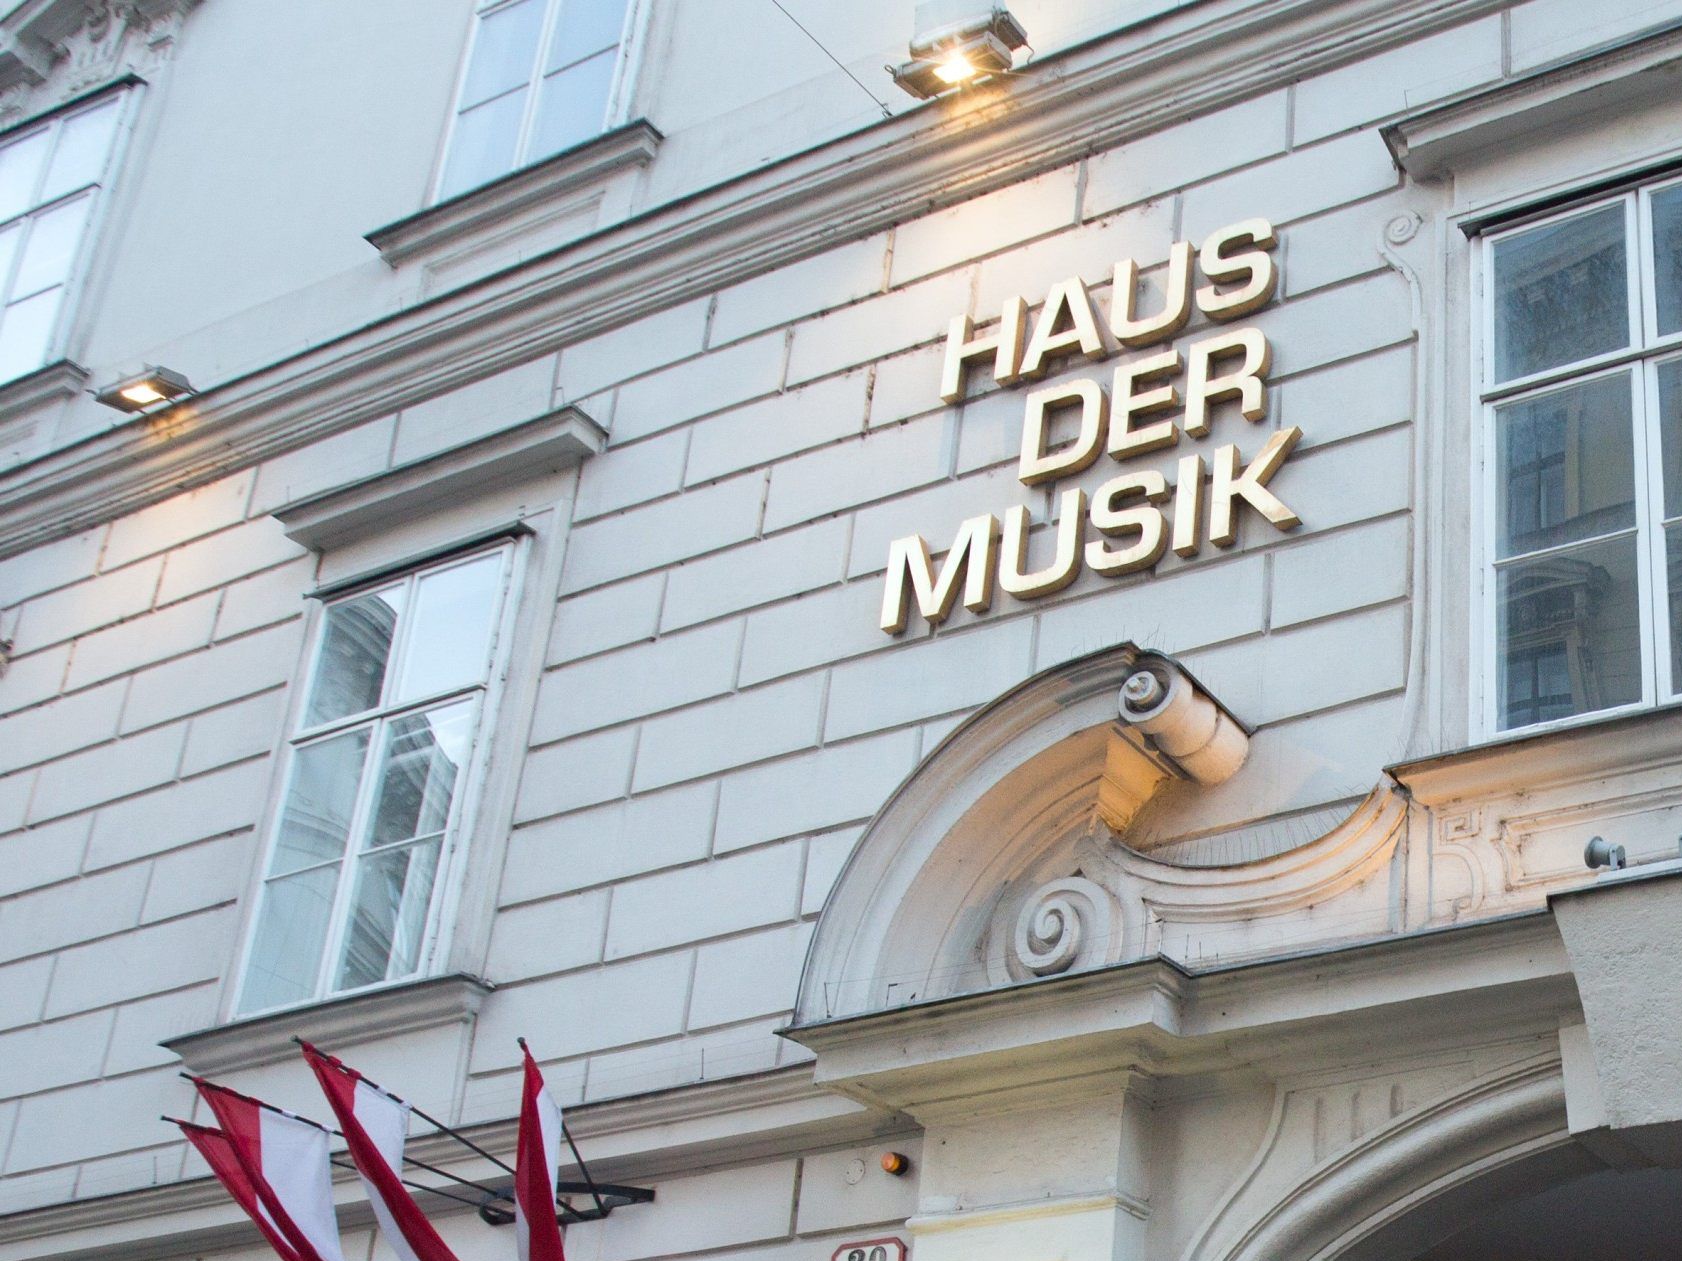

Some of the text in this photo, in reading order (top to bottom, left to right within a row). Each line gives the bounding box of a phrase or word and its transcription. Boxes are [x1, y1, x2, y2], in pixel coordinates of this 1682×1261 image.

[940, 217, 1277, 405] HAUS
[1018, 328, 1273, 486] DER
[880, 425, 1303, 635] MUSIK
